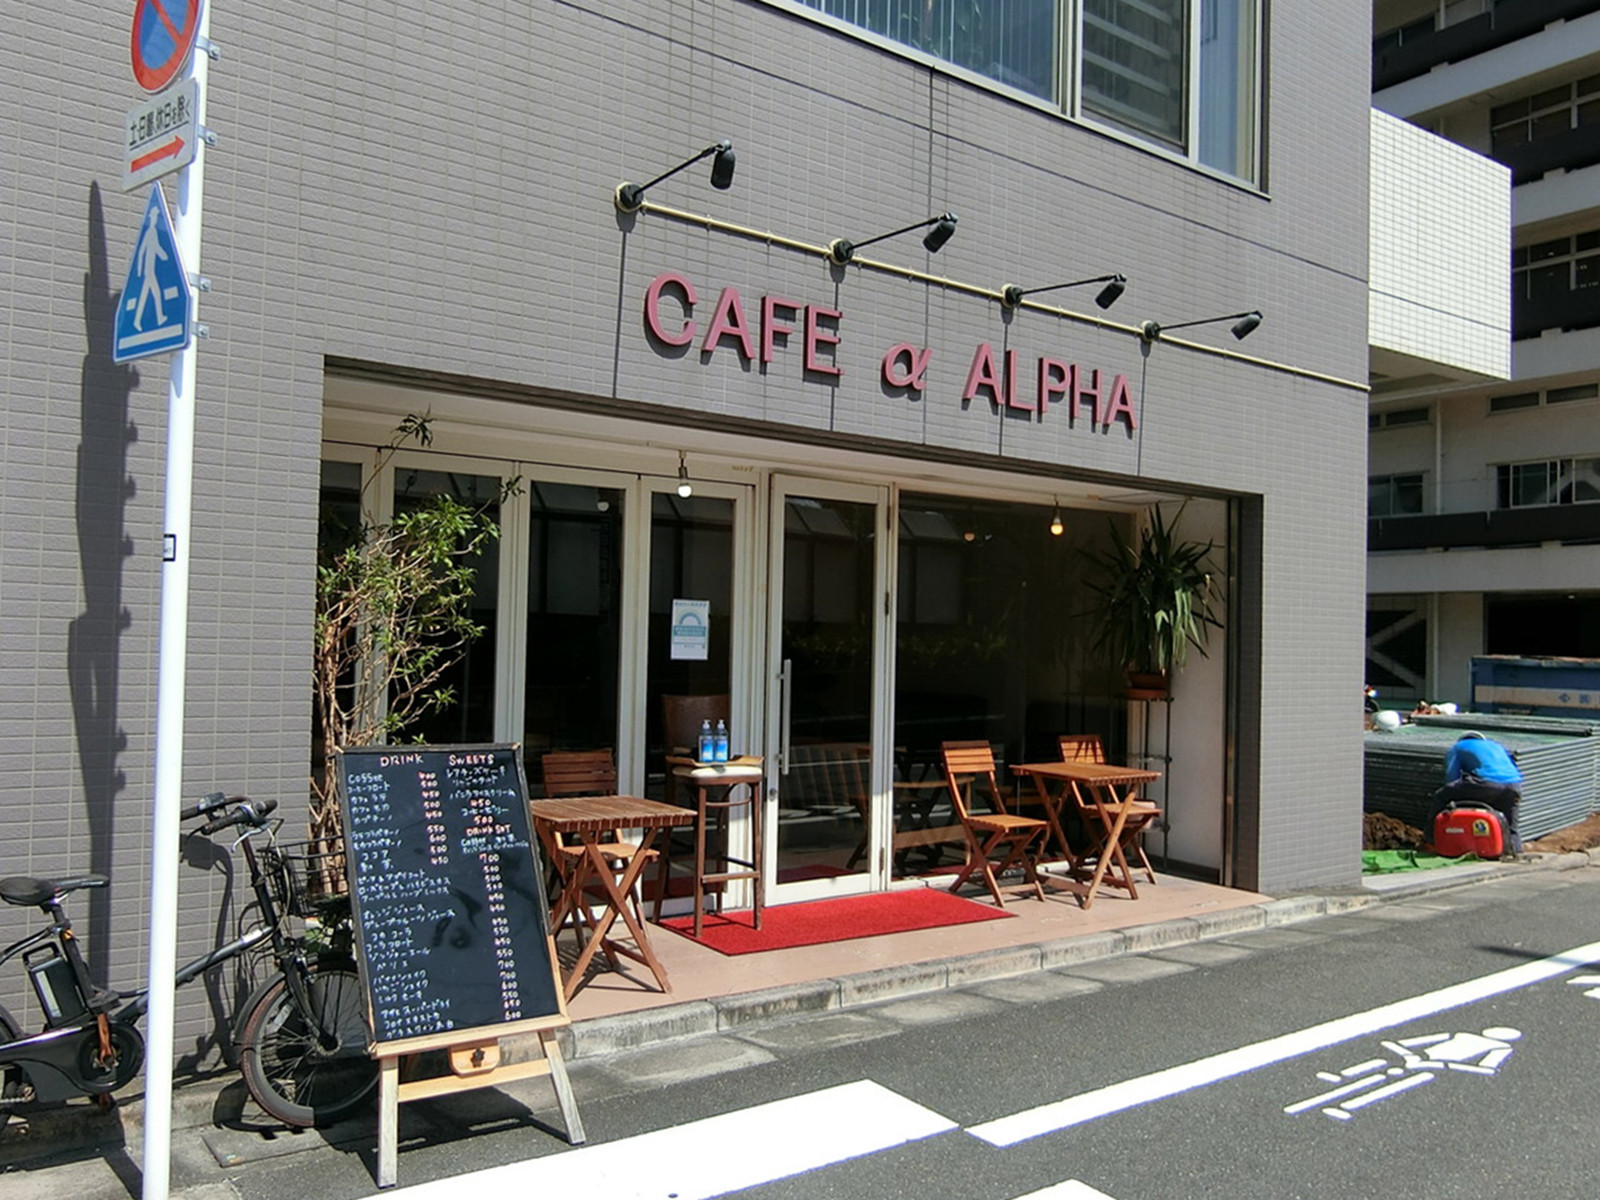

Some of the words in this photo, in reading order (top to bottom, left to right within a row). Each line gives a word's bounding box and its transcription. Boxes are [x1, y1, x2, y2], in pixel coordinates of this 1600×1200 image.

[644, 272, 845, 377] CAFE
[962, 343, 1138, 430] ALPHA
[380, 753, 424, 767] DRINK
[449, 753, 495, 766] SWEETS
[420, 780, 438, 788] 500
[422, 790, 440, 798] 450
[423, 800, 441, 809] 500
[470, 798, 491, 807] 450
[425, 810, 443, 819] 450
[473, 815, 494, 825] 500
[427, 824, 445, 833] 550
[429, 833, 447, 842] 600
[430, 845, 448, 854] 500
[431, 856, 449, 865] 450
[479, 853, 500, 863] 700
[483, 865, 500, 873] 500
[485, 874, 501, 883] 500
[493, 926, 510, 936] 550
[496, 948, 513, 958] 550
[497, 959, 515, 969] 700
[499, 971, 516, 980] 700
[501, 981, 518, 990] 600
[502, 990, 519, 1000] 550
[504, 1010, 522, 1021] 600
